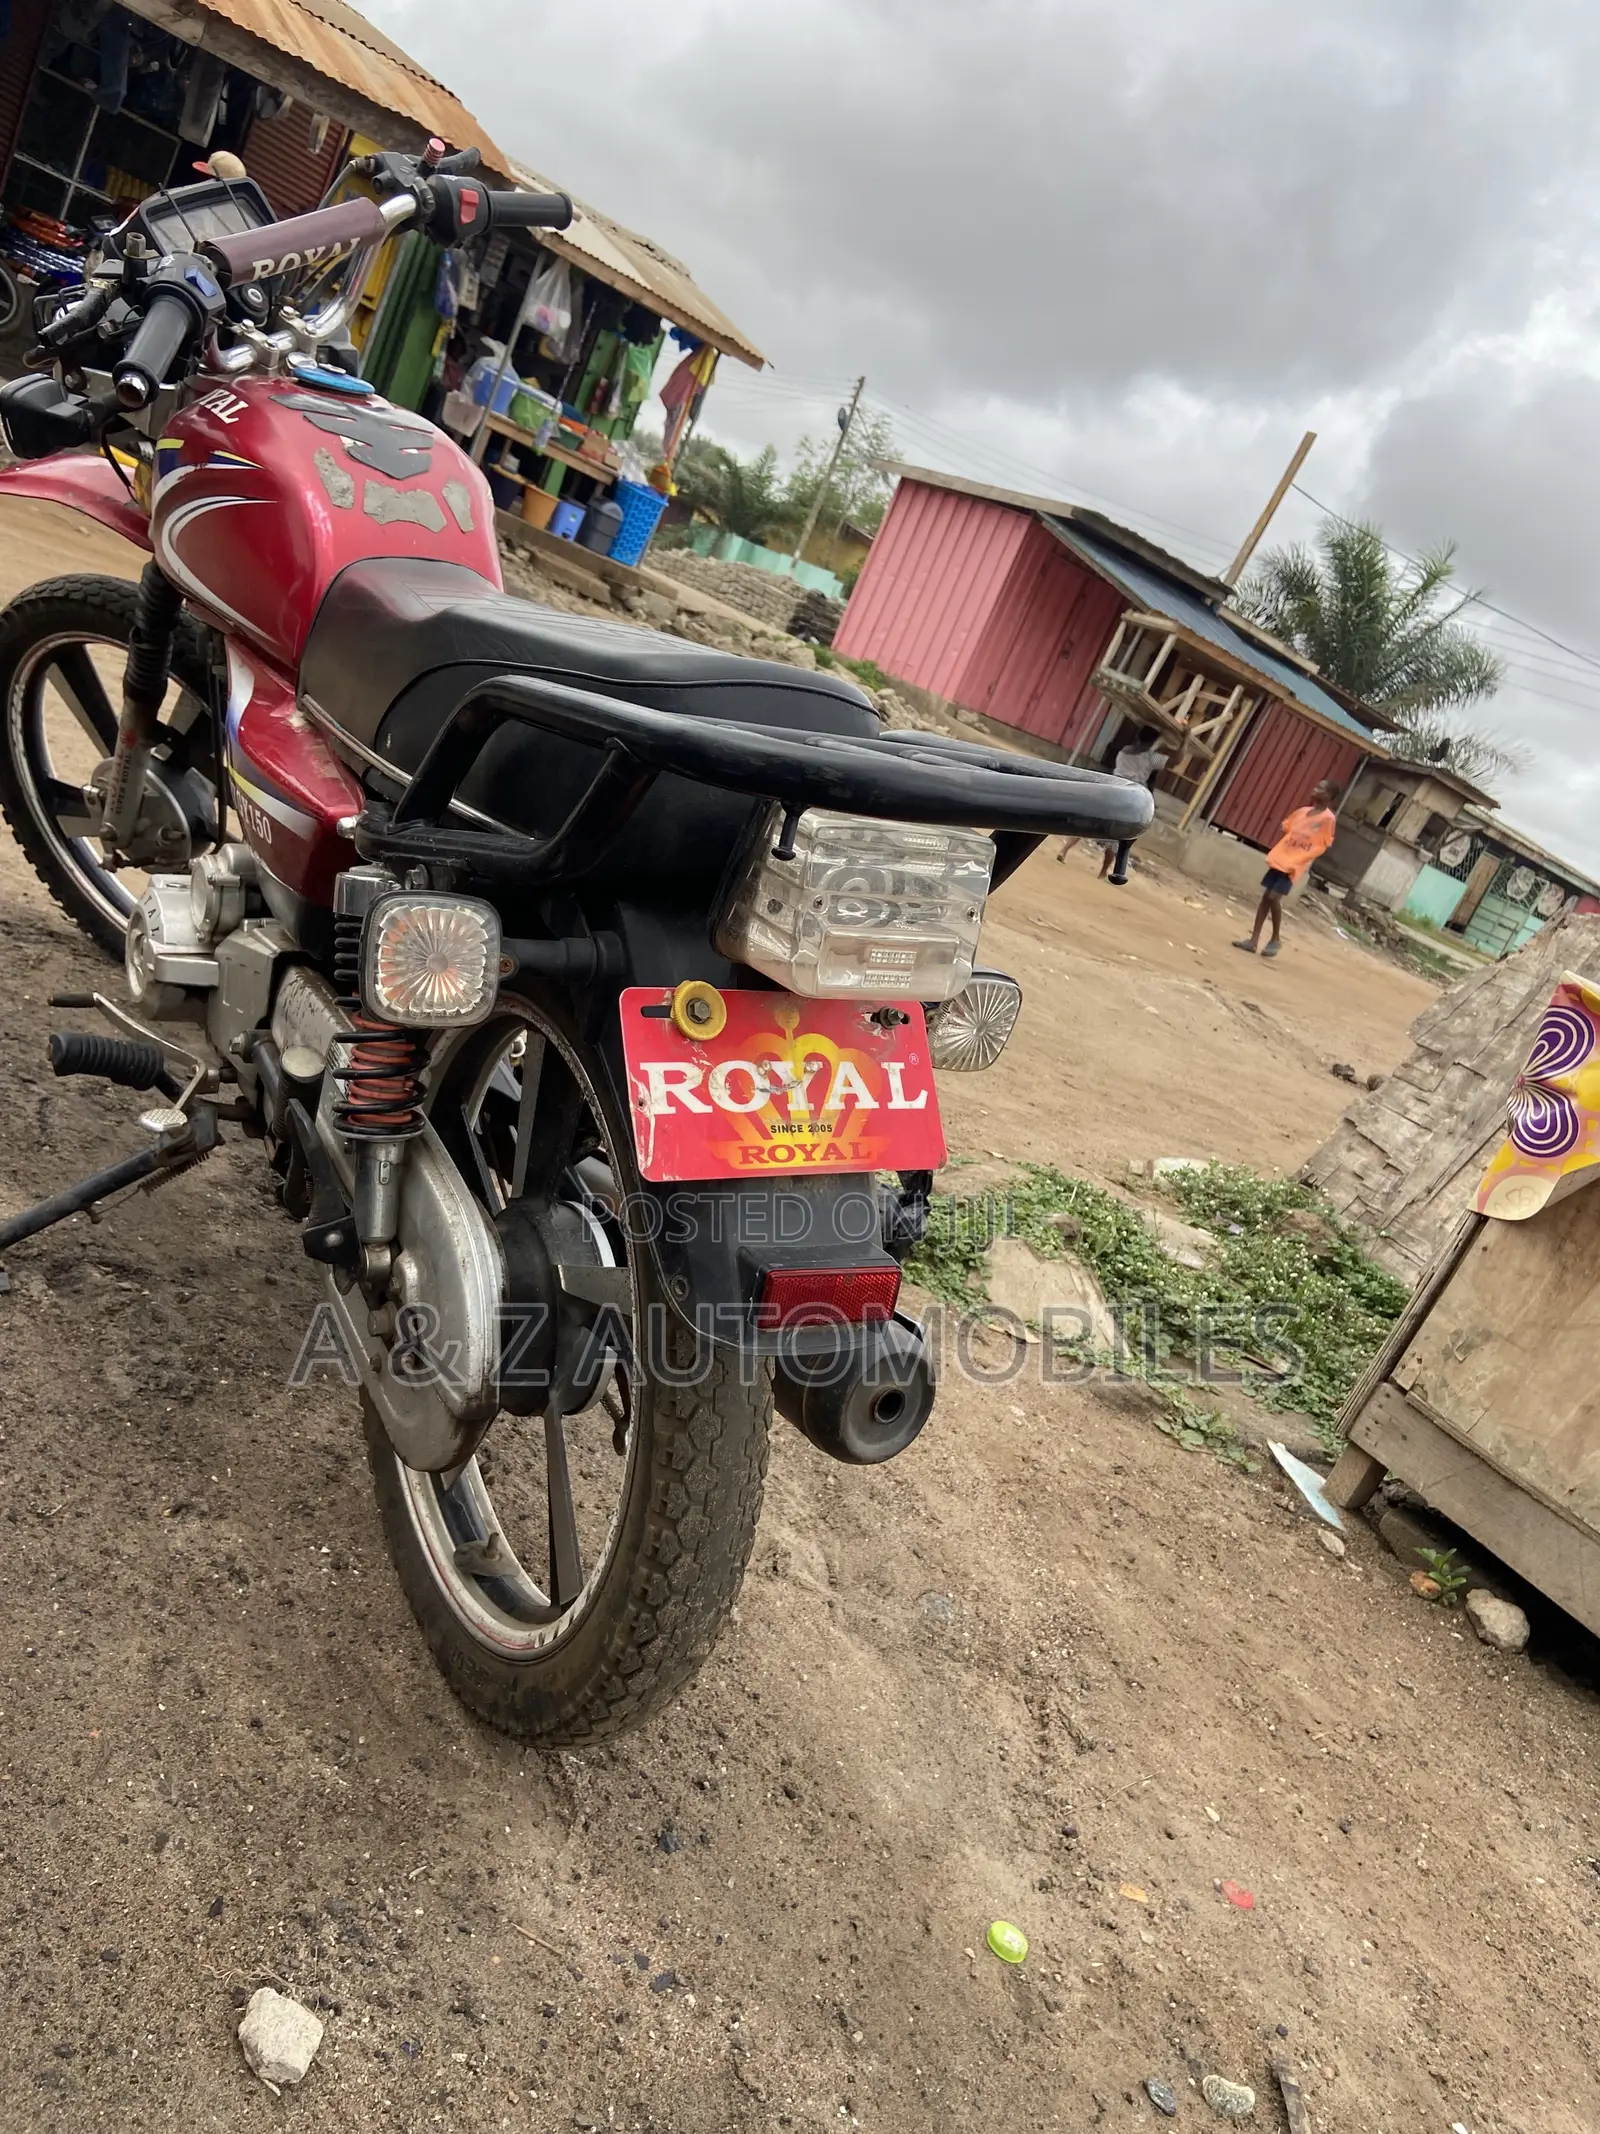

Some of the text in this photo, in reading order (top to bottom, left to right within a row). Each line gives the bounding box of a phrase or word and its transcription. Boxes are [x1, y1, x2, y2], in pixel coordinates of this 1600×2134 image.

[640, 1060, 928, 1114] ROYAL
[770, 1124, 833, 1134] SINCE 2005
[738, 1141, 872, 1166] ROYAL
